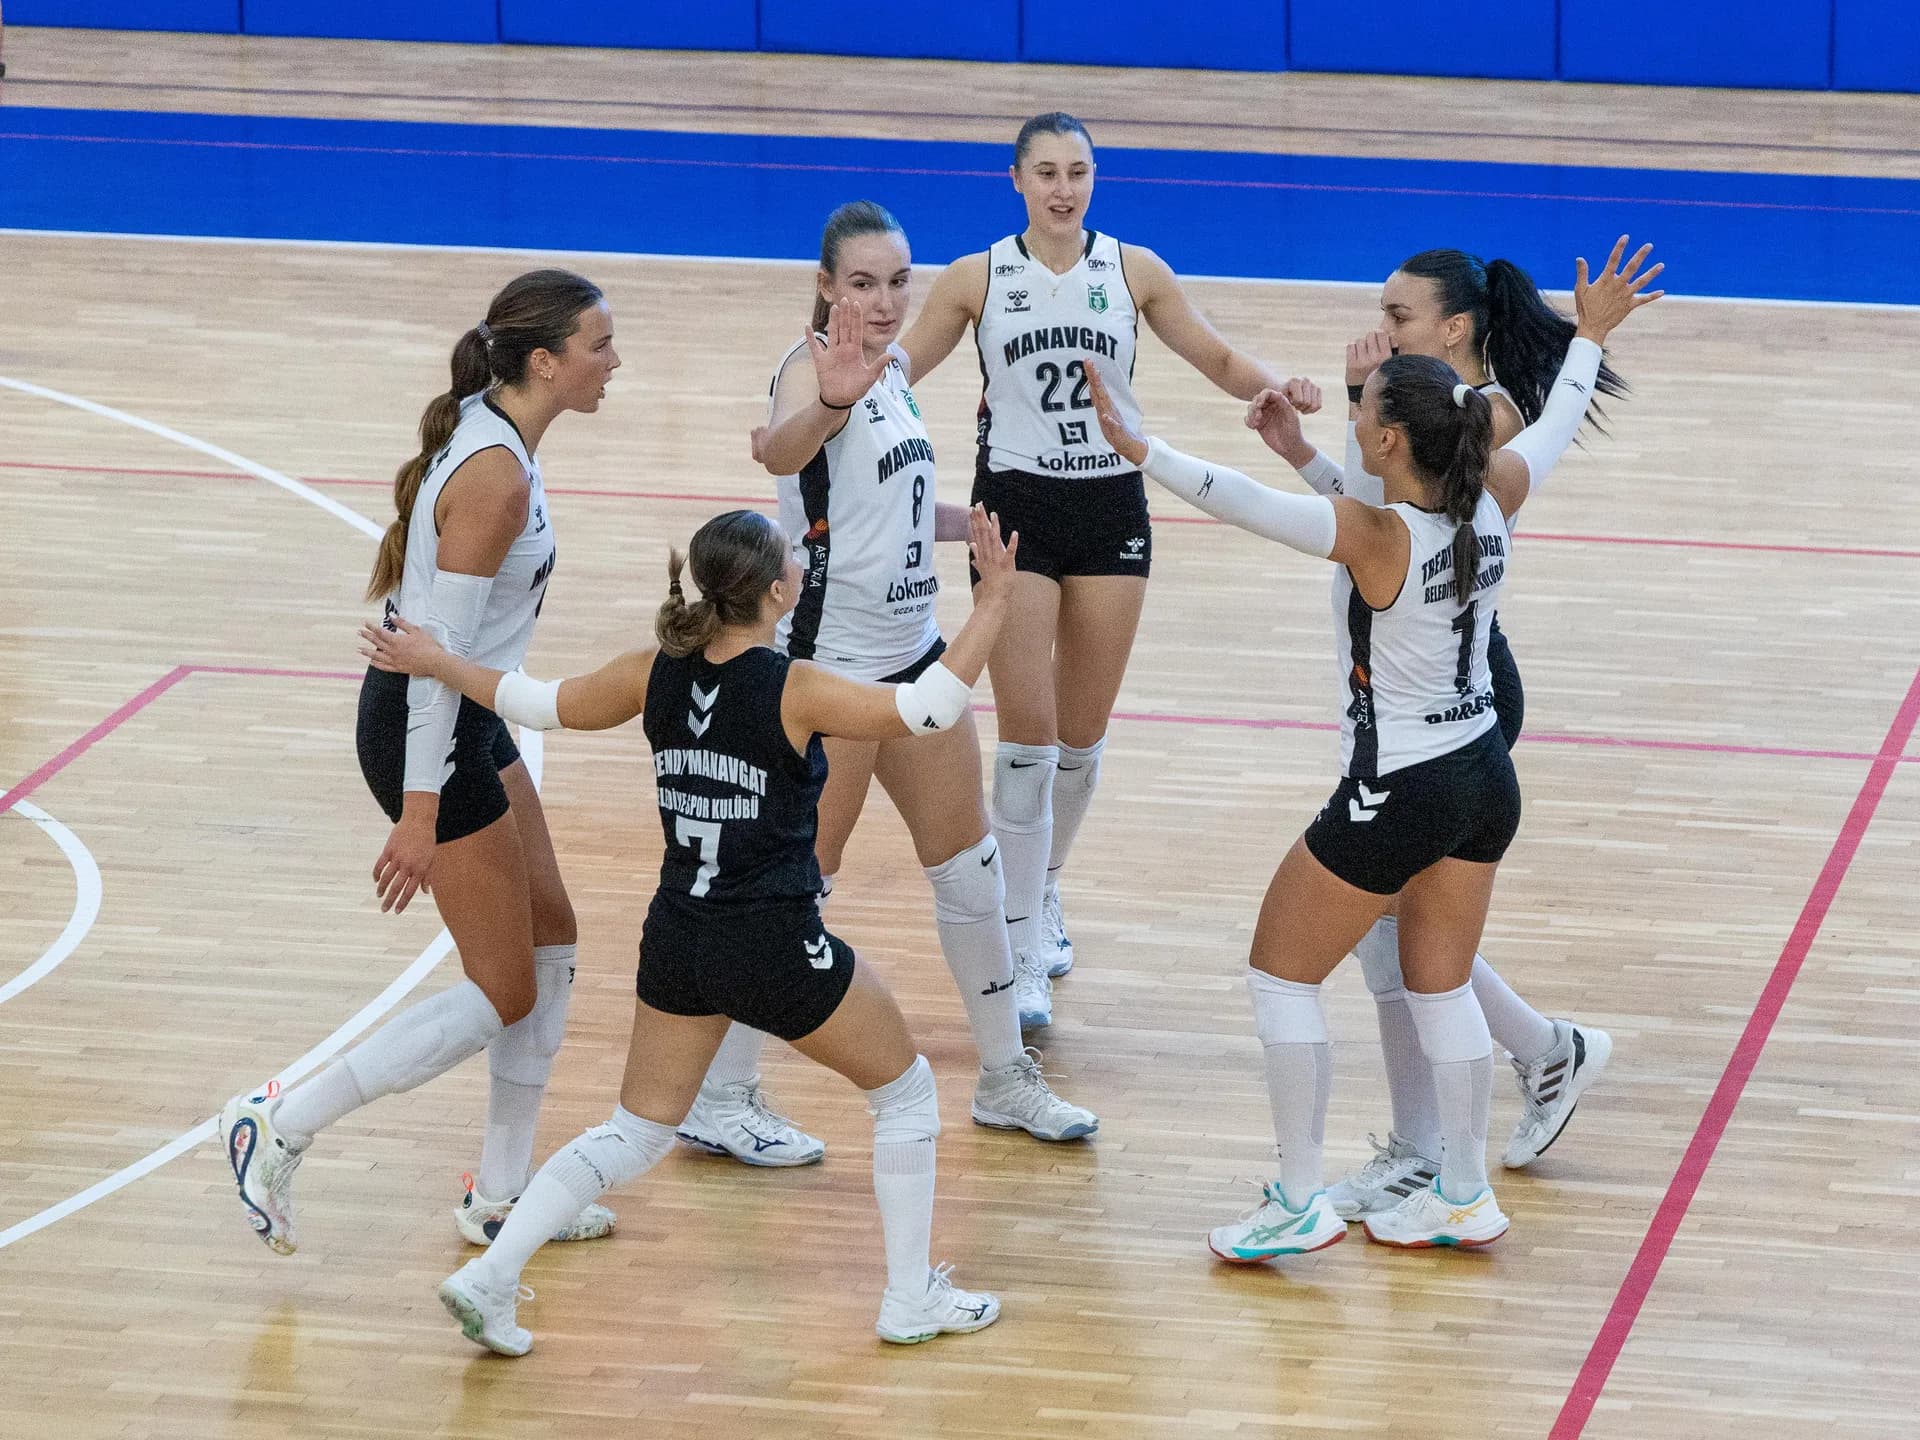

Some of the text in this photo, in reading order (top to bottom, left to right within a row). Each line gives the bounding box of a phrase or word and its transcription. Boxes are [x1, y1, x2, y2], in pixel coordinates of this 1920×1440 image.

[1003, 326, 1119, 367] MANAVGAT
[1035, 360, 1094, 413] 22
[1037, 451, 1121, 471] Lokman
[912, 474, 926, 532] 8
[886, 575, 939, 603] Lokman
[1450, 600, 1479, 699] 1
[653, 749, 767, 797] ENDYMANAVGAT
[711, 794, 759, 819] KULÜBÜ
[675, 815, 722, 898] 7
